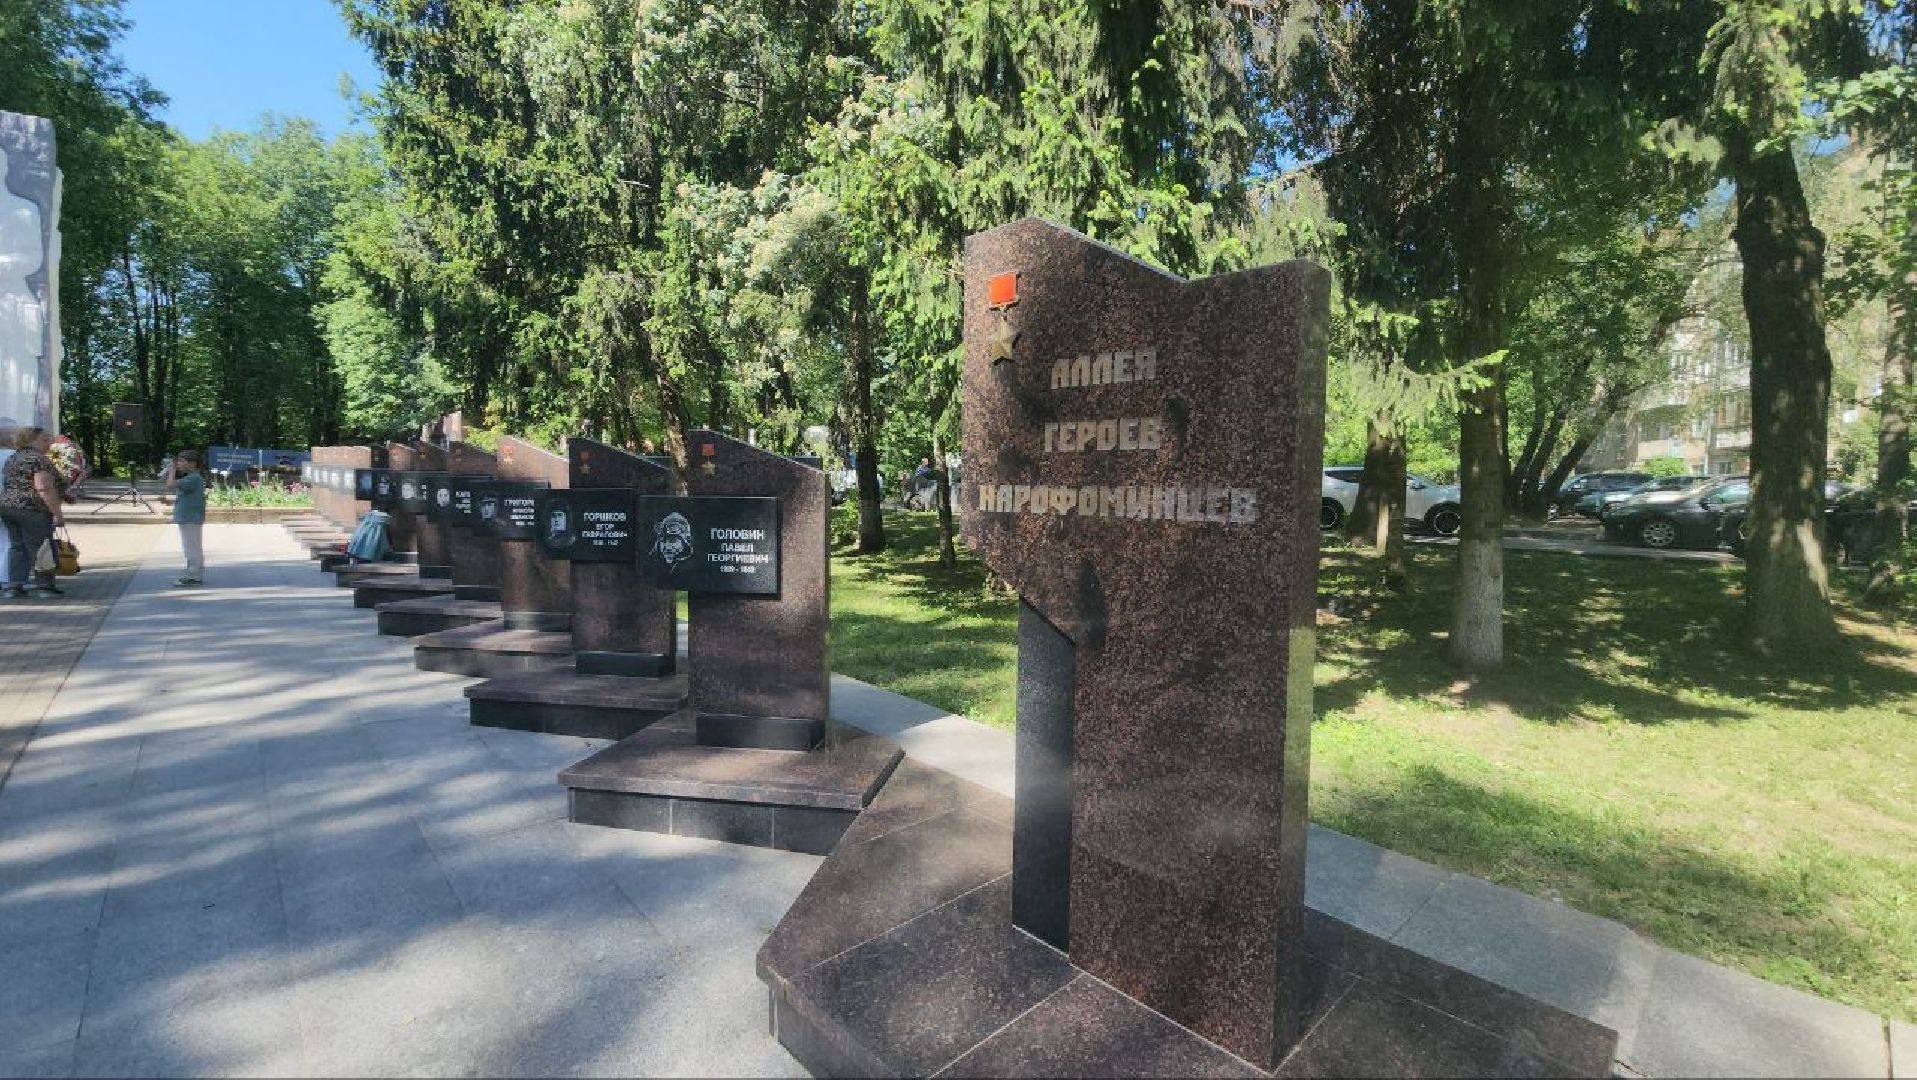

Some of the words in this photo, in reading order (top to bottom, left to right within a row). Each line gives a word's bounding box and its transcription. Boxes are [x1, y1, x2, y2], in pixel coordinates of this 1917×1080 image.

[1051, 349, 1157, 390] АЛЛЕЯ
[1044, 416, 1163, 452] ГЕРОЕВ
[980, 484, 1259, 525] НАРОФОМИНЦЕВ
[710, 527, 766, 541] ГОЛОВИН
[707, 553, 770, 564] ГЕОРГИЕВИЧ
[720, 542, 754, 553] ПАВЕЛ
